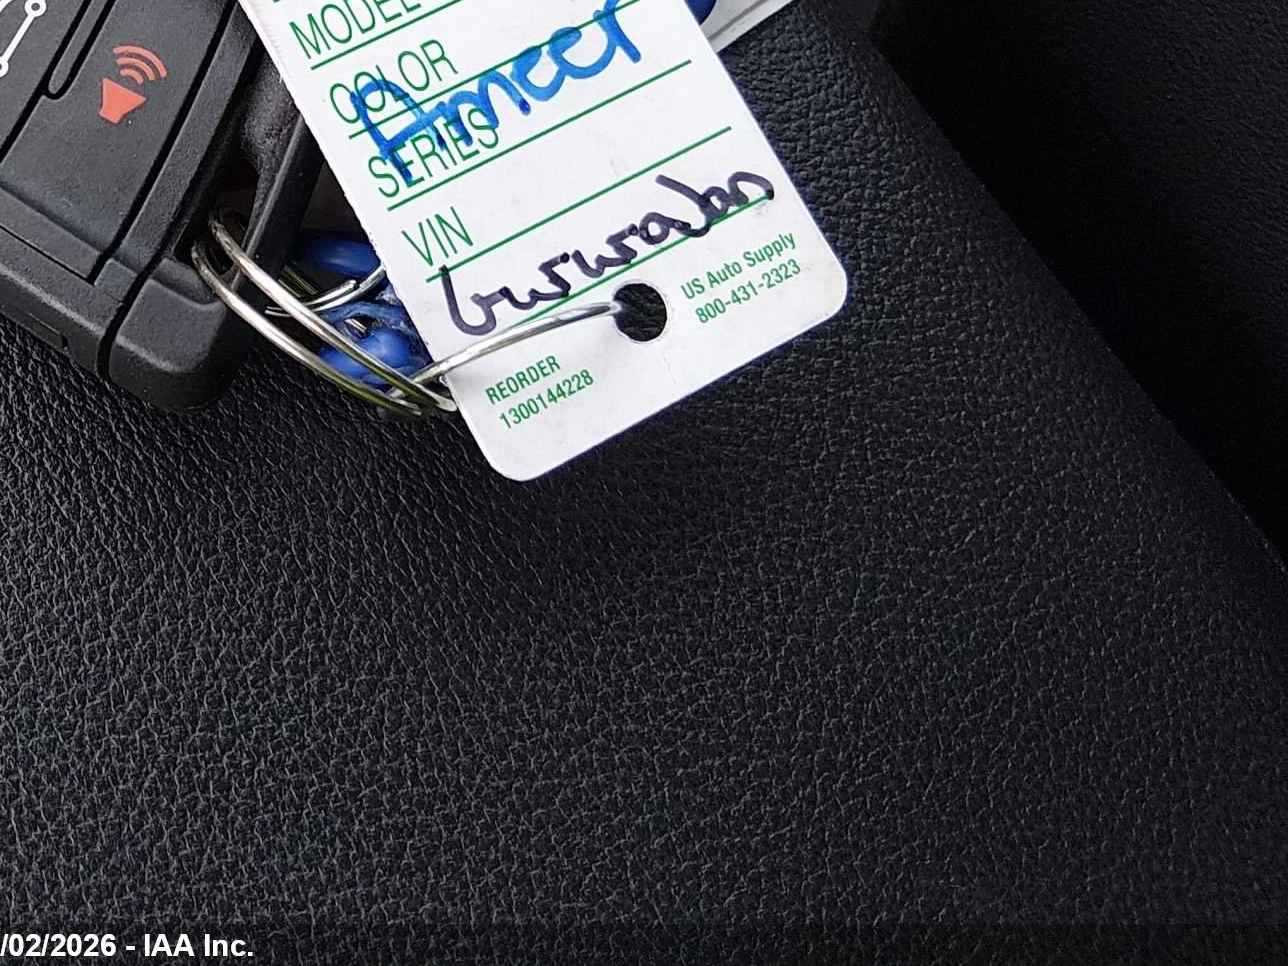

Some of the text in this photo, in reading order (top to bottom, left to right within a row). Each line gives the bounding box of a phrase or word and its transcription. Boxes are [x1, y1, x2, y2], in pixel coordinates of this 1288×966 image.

[329, 39, 459, 125] COLOR
[367, 107, 500, 198] SERIES
[400, 205, 474, 267] VIN
[680, 233, 796, 300] US Auto Supply
[694, 258, 802, 324] 800-431-2323
[484, 354, 561, 406] REORDER
[499, 369, 594, 429] 1300144228
